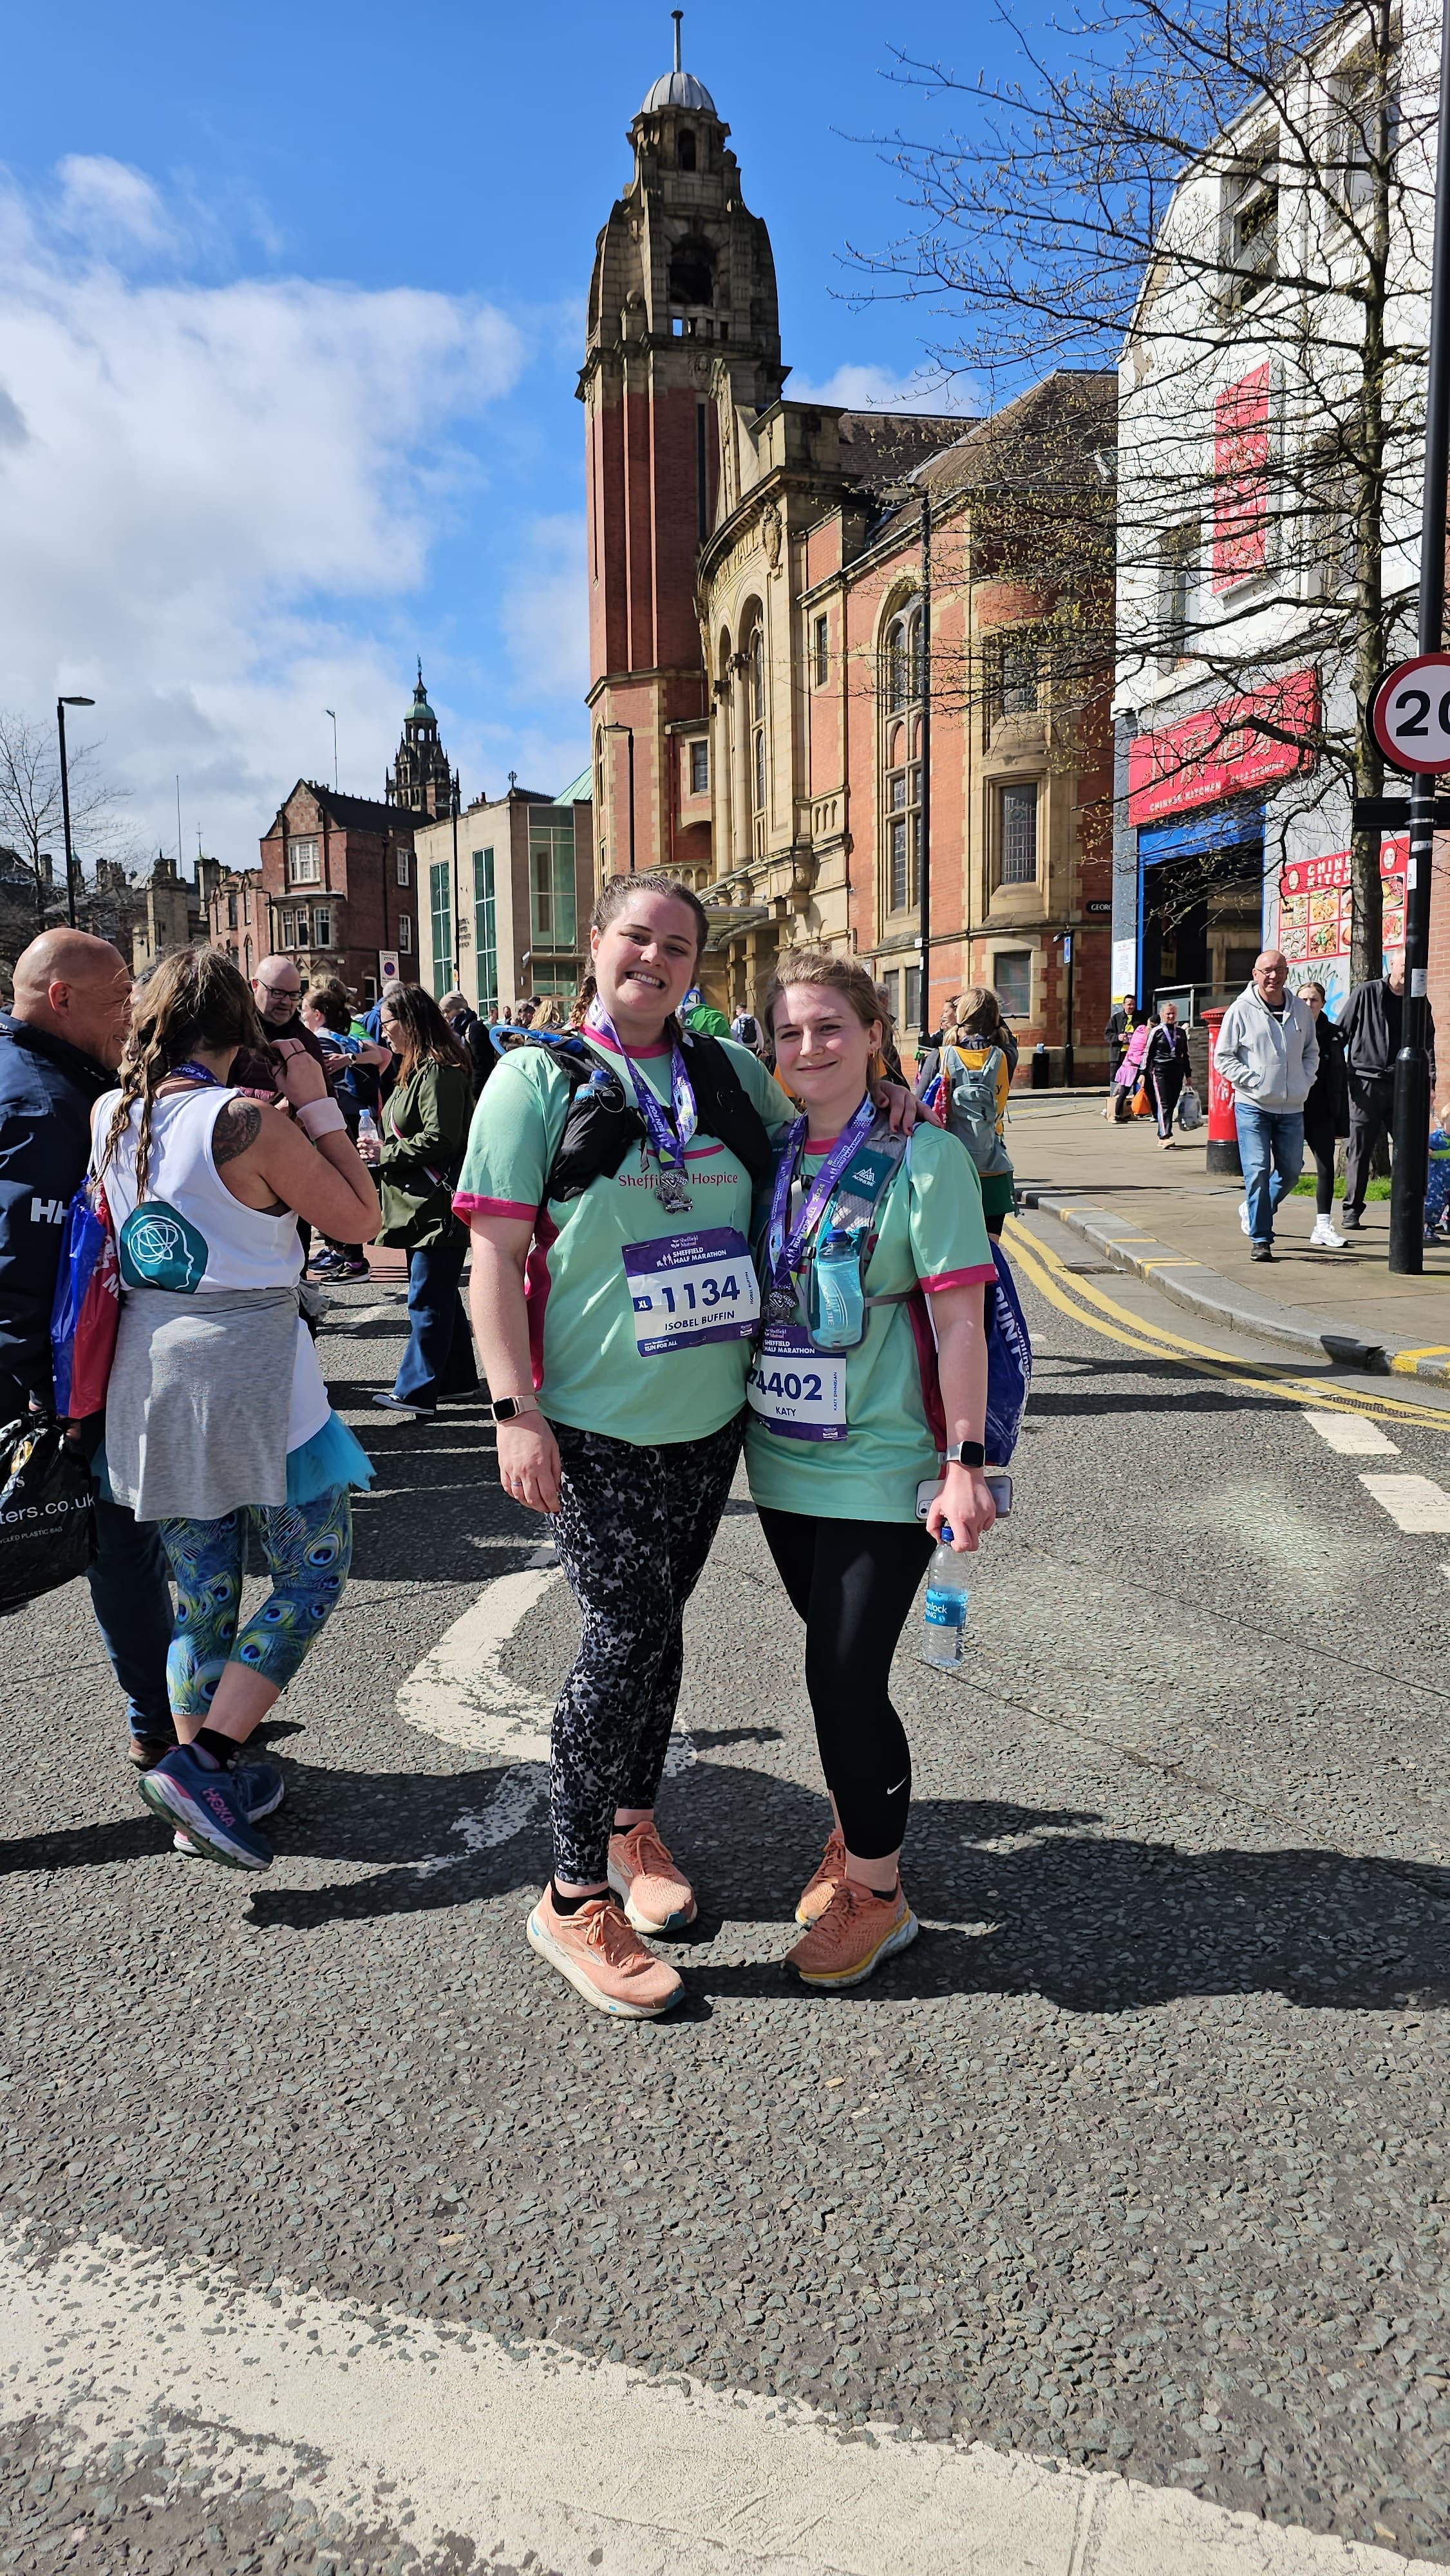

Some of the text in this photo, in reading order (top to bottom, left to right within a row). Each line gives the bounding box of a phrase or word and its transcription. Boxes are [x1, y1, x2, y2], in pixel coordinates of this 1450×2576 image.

[1149, 781, 1221, 811] CHINESE KITCHEN
[1307, 855, 1351, 876] CHINE
[1307, 869, 1351, 889] KITCH
[196, 1072, 207, 1080] ALL
[650, 1104, 660, 1118] FOR
[655, 1118, 666, 1133] RUN
[845, 1132, 864, 1159] MARATHON
[618, 1171, 738, 1189] Sheffi Hospice
[808, 1206, 818, 1218] ALL
[813, 1184, 825, 1202] 2024
[672, 1247, 704, 1258] SHEFFIELD
[673, 1249, 727, 1264] HALF MARATHON
[661, 1275, 740, 1312] 1134
[637, 1300, 648, 1309] XL
[665, 1311, 735, 1331] ISOBEL BUFFIN
[775, 1406, 796, 1417] KATY
[21, 1528, 50, 1539] PLASTIC
[202, 1786, 236, 1828] HOKA
